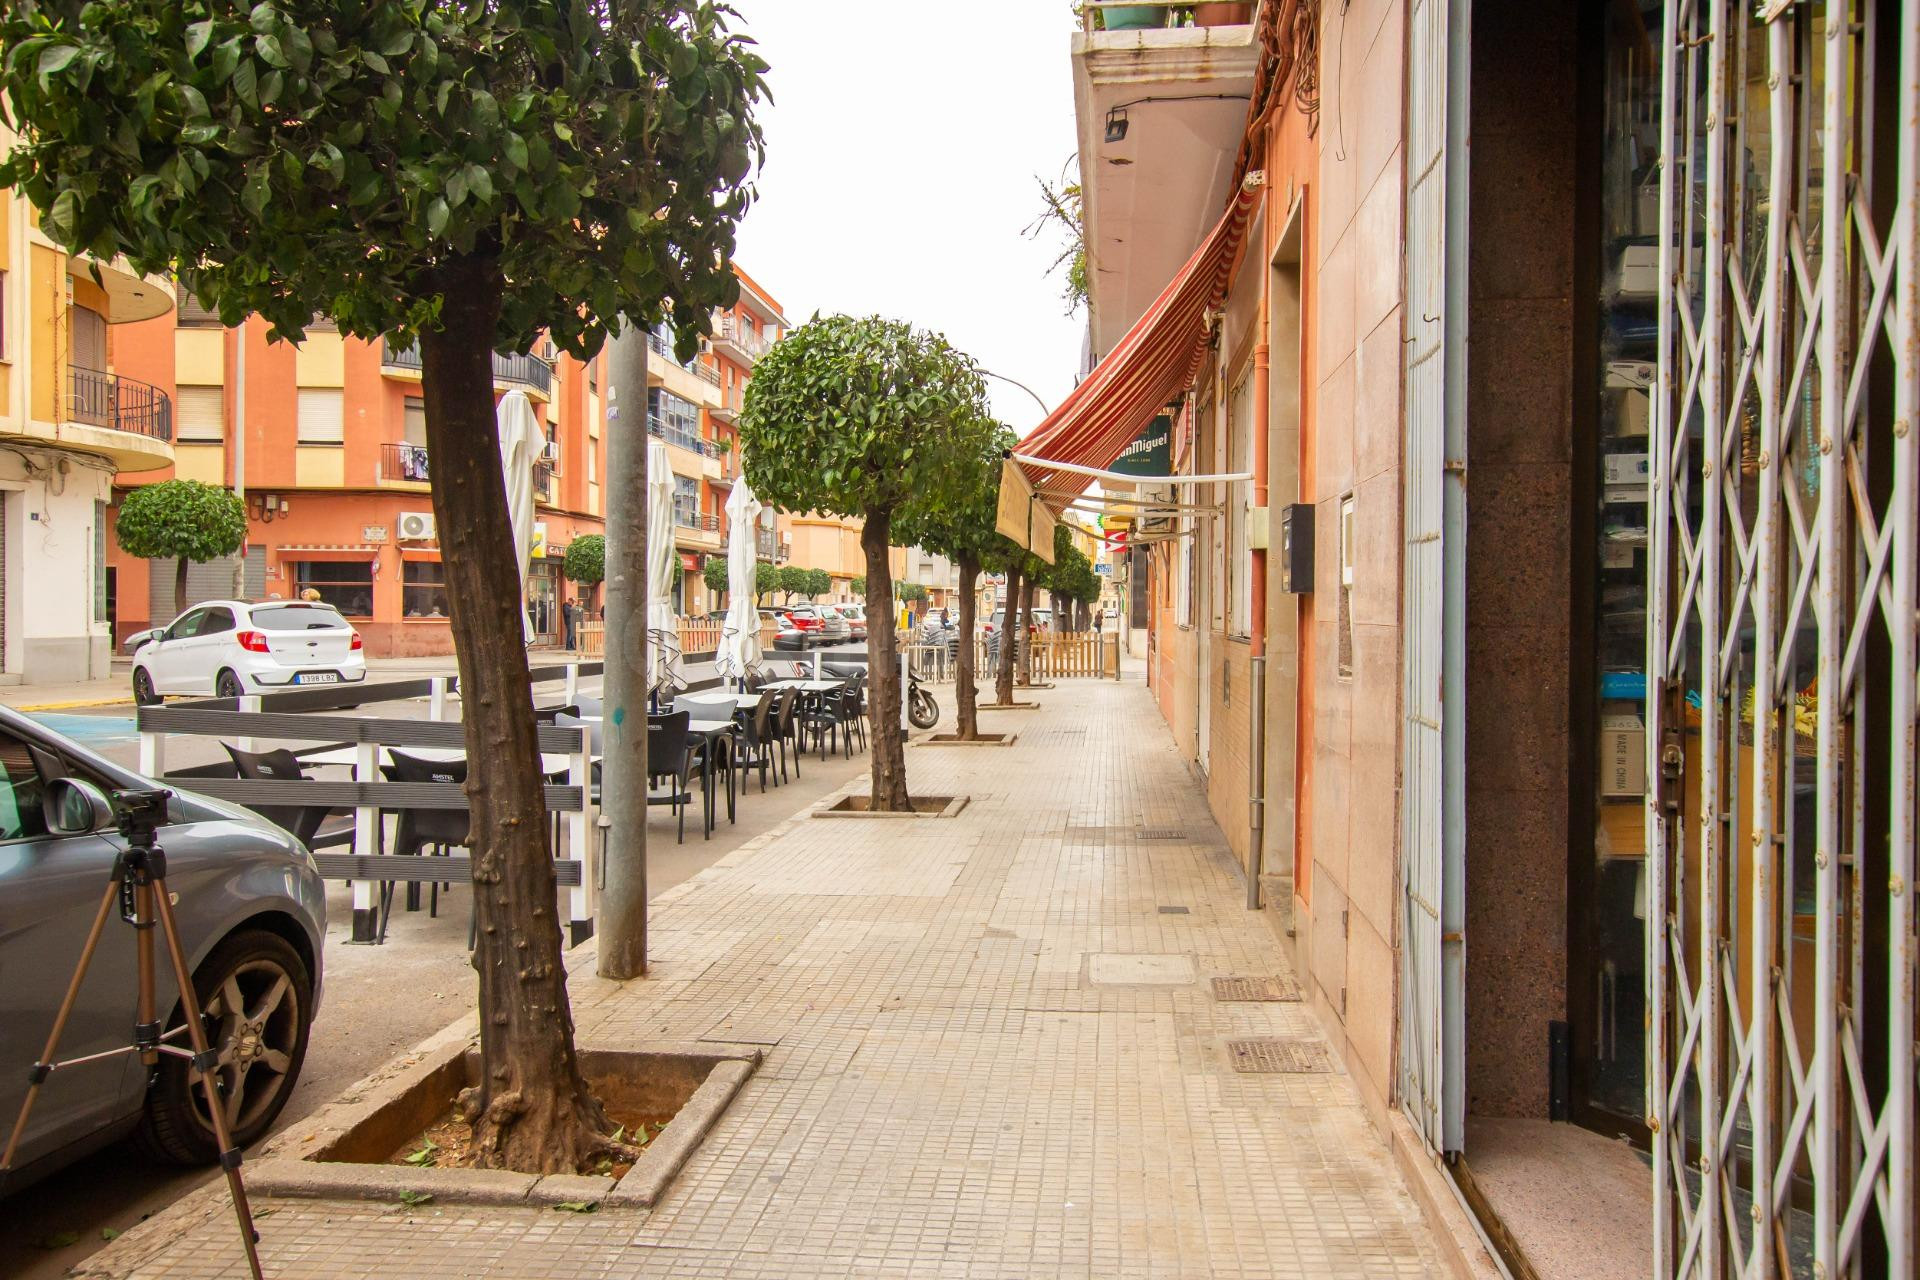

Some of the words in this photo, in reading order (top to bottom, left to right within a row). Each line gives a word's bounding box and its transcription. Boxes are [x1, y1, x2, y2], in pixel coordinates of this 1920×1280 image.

[1616, 734, 1627, 754] MADE
[1616, 757, 1627, 765] IN
[1616, 767, 1627, 790] CHINA
